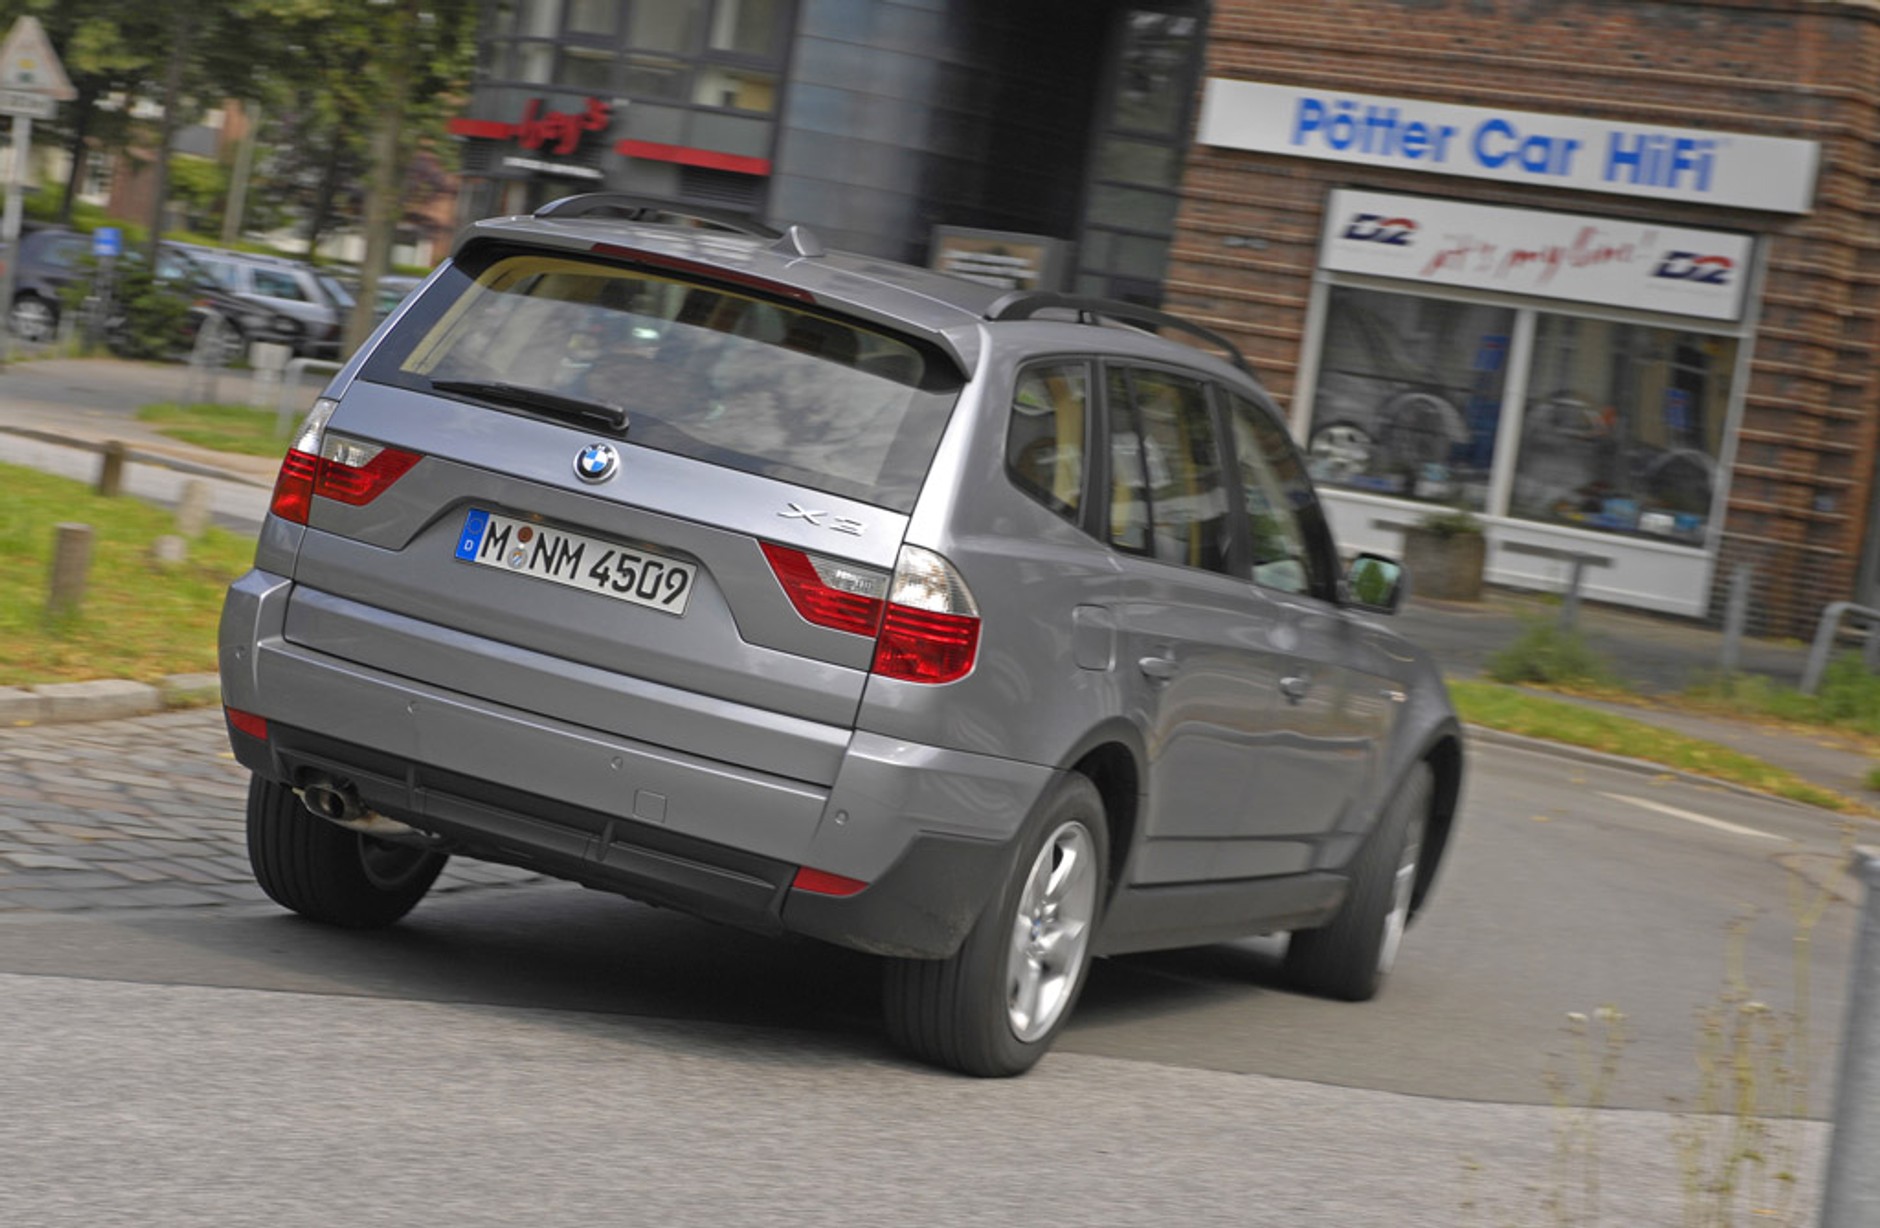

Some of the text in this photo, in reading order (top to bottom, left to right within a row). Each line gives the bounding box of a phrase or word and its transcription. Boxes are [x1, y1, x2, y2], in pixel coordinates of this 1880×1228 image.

[1290, 97, 1718, 192] Pötter Car HiFi
[1341, 213, 1419, 246] D2
[1651, 250, 1735, 286] D2
[776, 503, 869, 537] X3
[480, 521, 690, 605] M NM 4509
